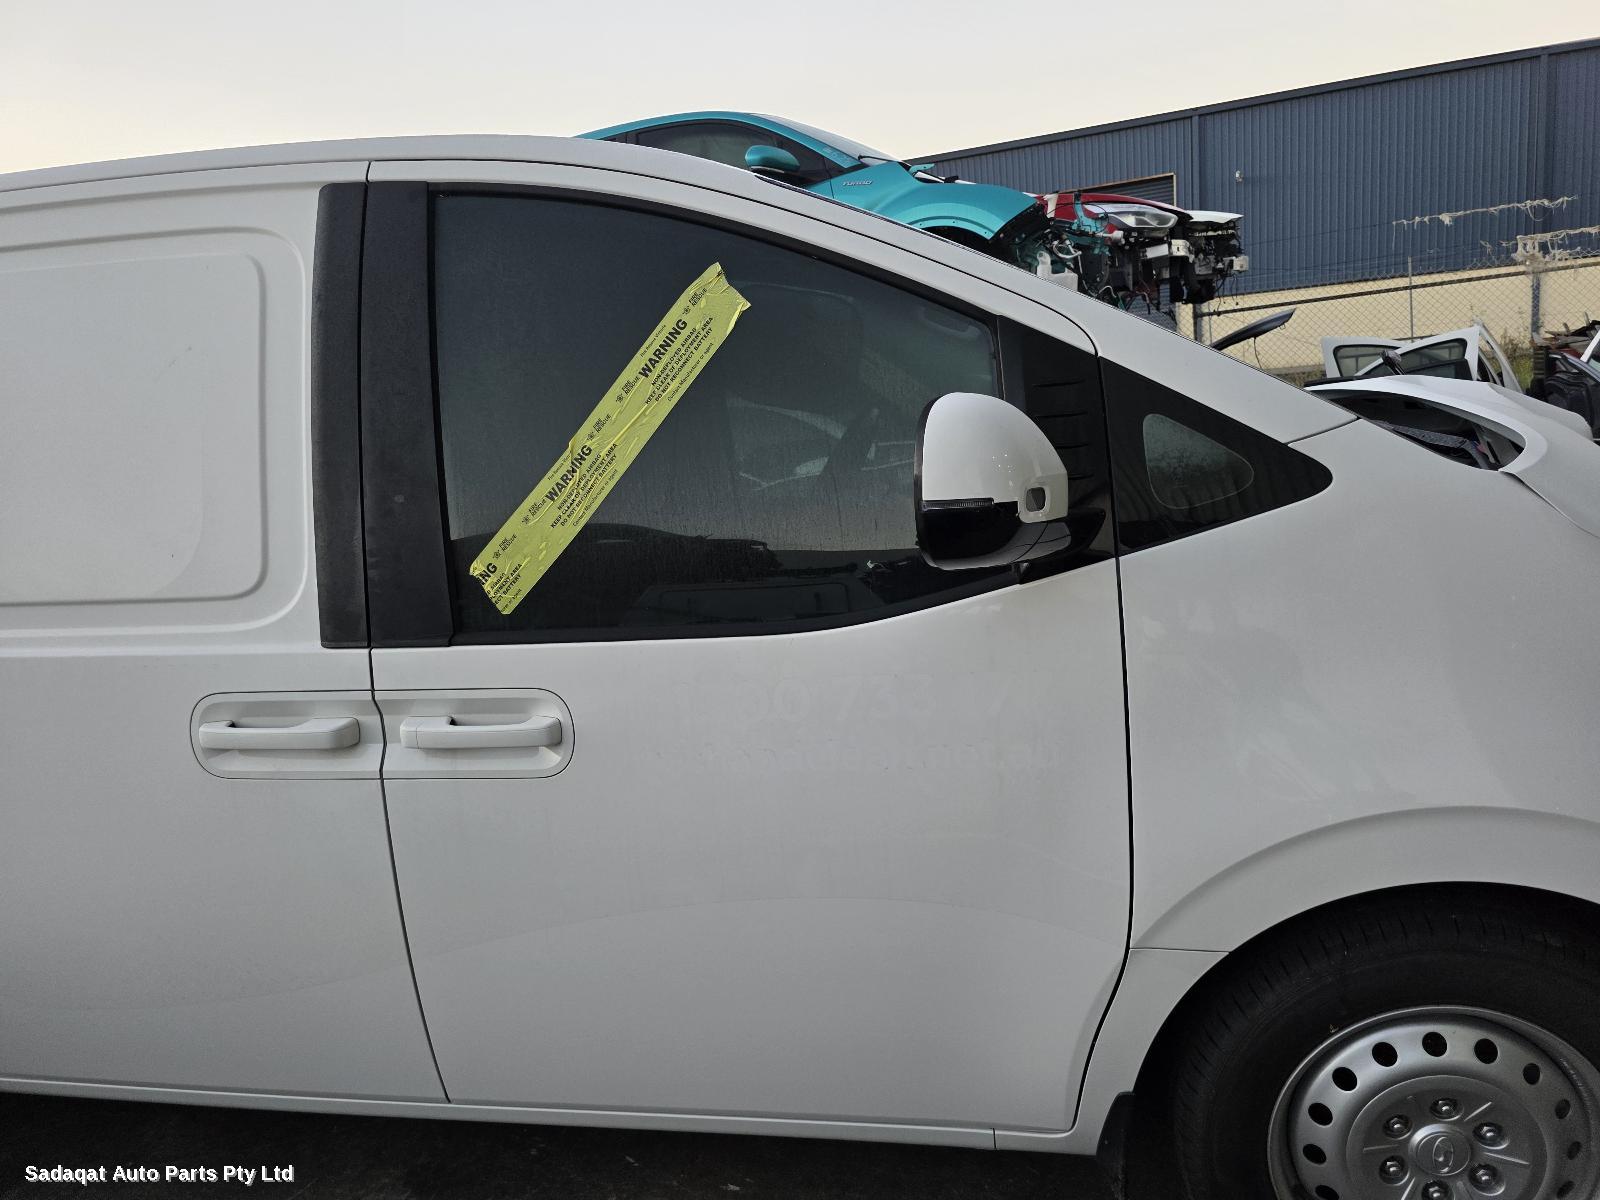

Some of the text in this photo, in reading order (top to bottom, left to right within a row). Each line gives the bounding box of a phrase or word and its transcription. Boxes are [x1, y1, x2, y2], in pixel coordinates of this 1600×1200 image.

[638, 318, 688, 379] WARNING
[644, 389, 656, 404] KEEP
[655, 372, 671, 391] CLEAR
[674, 330, 702, 366] DEPLOYMENT
[701, 317, 713, 332] AREA
[654, 327, 713, 402] DO NOT RECONNECT BATTERY
[544, 444, 593, 503] WARNING
[550, 514, 562, 529] KEEP
[561, 498, 576, 515] CLEAR
[579, 457, 607, 492] DEPLOYMENT
[605, 443, 618, 459] AREA
[560, 518, 568, 527] DO
[566, 507, 577, 519] NOT
[598, 453, 617, 478] BATTERY
[502, 572, 521, 596] BATTERY
[510, 563, 523, 577] AREA
